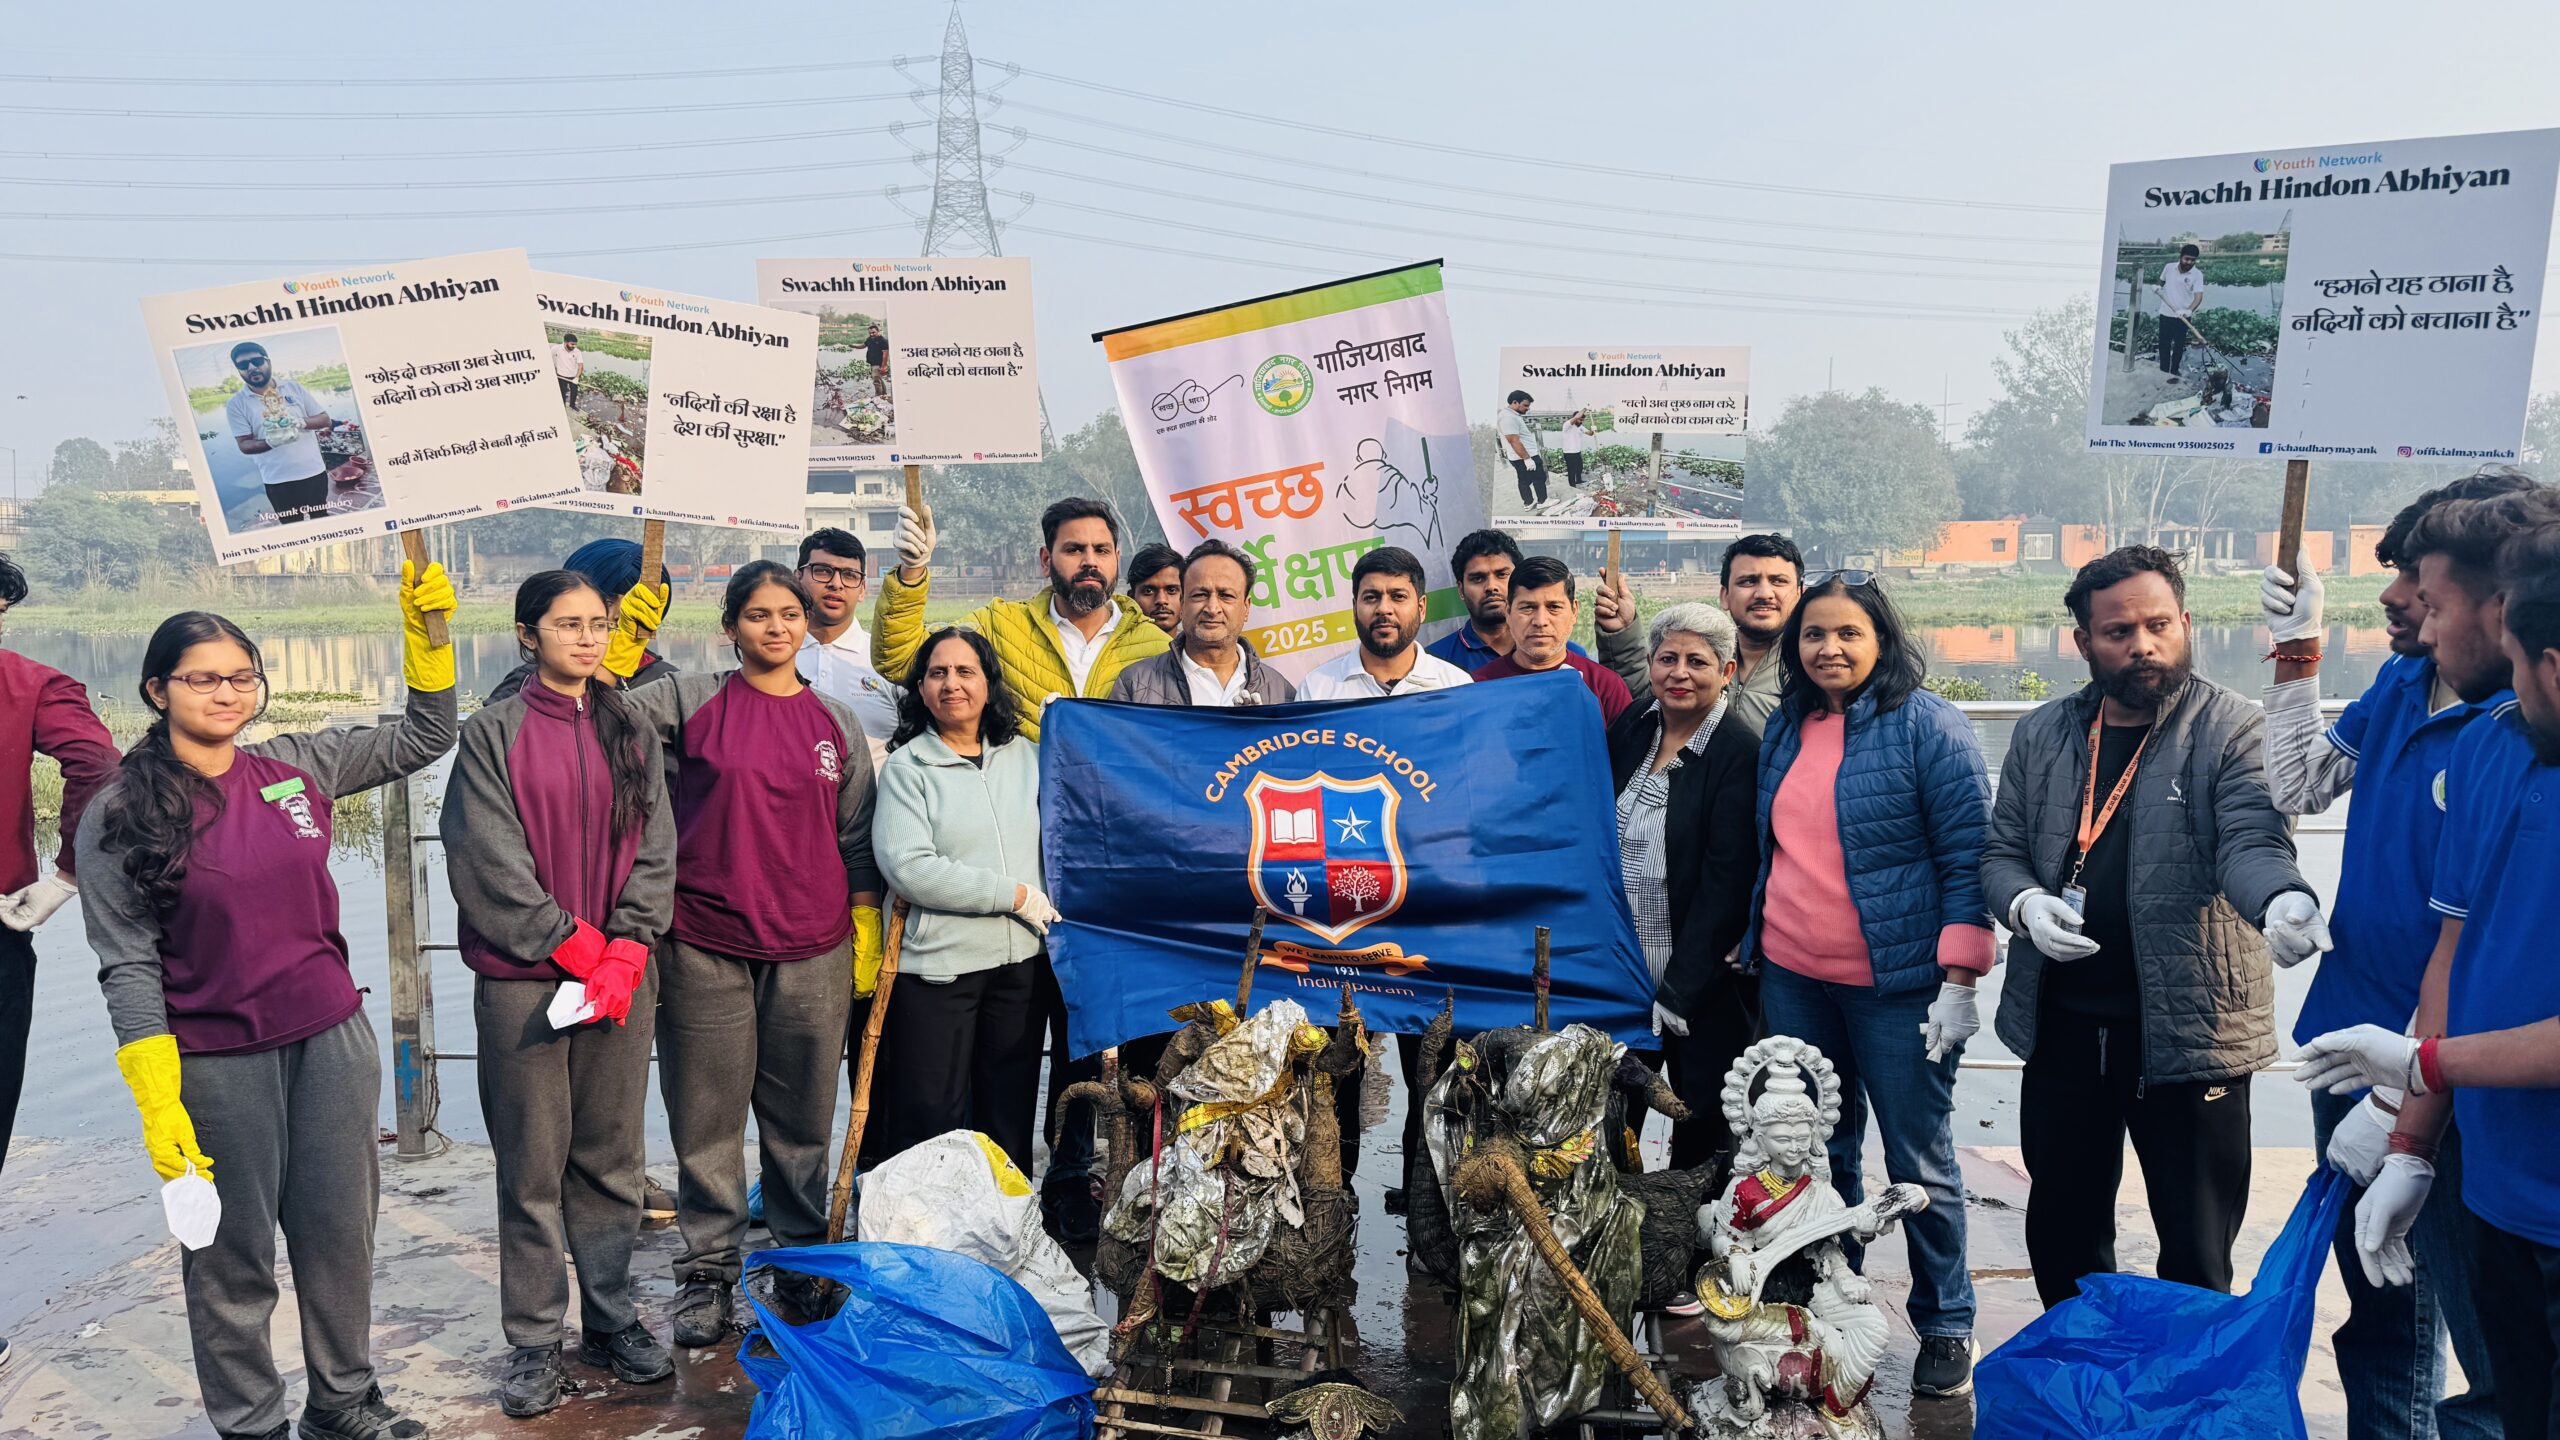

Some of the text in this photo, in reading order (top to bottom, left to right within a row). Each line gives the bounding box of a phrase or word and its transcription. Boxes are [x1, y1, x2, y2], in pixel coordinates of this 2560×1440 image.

[2273, 152, 2382, 172] Youth Network
[2144, 164, 2510, 208] Swachh Hindon Abhiyan
[864, 264, 932, 272] Youth Network
[301, 271, 395, 293] Youth Network
[782, 276, 1006, 294] Swachh Hindon Abhiyan
[2387, 277, 2424, 295] यह
[2428, 274, 2486, 293] ठाना
[186, 277, 500, 333] Swachh Hindon Abhiyan
[634, 294, 710, 314] Youth Network
[536, 294, 789, 348] Swachh Hindon Abhiyan
[2292, 308, 2364, 332] नदियों
[2368, 305, 2405, 331] को
[2408, 310, 2492, 330] बचाना
[931, 343, 961, 358] हमने
[962, 348, 982, 358] यह
[983, 346, 1012, 358] ठाना
[1314, 332, 1426, 374] गाजियाबाद
[1601, 352, 1662, 360] Youth Network
[402, 363, 417, 380] दो
[419, 358, 462, 377] करना
[464, 358, 489, 372] अब
[491, 350, 504, 366] से
[908, 362, 945, 378] नदियों
[948, 362, 966, 376] को
[968, 366, 1005, 377] बचाना
[1522, 363, 1726, 380] Swachh Hindon Abhiyan
[373, 386, 417, 407] नदियों
[419, 382, 442, 399] को
[444, 377, 473, 395] करो
[475, 377, 500, 392] अब
[1338, 381, 1378, 406] नगर
[1384, 369, 1434, 399] निगम
[1189, 396, 1204, 404] भारत
[1649, 399, 1668, 408] अब
[1672, 400, 1692, 411] कुछ
[1694, 400, 1714, 408] नाम
[724, 399, 748, 416] की
[752, 404, 780, 421] रक्षा
[784, 405, 796, 424] है
[1618, 413, 1638, 424] नदी
[1640, 414, 1670, 424] बचाने
[1672, 416, 1686, 424] का
[1688, 416, 1713, 424] काम
[674, 415, 700, 437] देश
[705, 422, 730, 440] की
[388, 426, 558, 467] नदी में सिर्फ मिट्टी से बनी मूर्ति डालें
[2089, 438, 2235, 450] Join The Movement 9350025025
[2272, 443, 2378, 456] /ichaudharymayank
[2410, 446, 2515, 459] /officialmayankch
[258, 498, 352, 521] Mayank Chaudhary
[569, 498, 614, 510] 9350025025
[1170, 462, 1324, 538] स्वच्छ
[222, 526, 364, 560] Join The Movement 9350025025
[1263, 620, 1328, 654] 2025
[1206, 729, 1439, 803] CAMBRIDGE SCHOOL
[1283, 946, 1303, 954] WE
[1306, 952, 1342, 960] LEARN
[1362, 948, 1392, 962] SERVE
[1334, 966, 1360, 976] 1931
[1297, 975, 1415, 996] Indirapuram
[2208, 1086, 2226, 1095] NIKE
